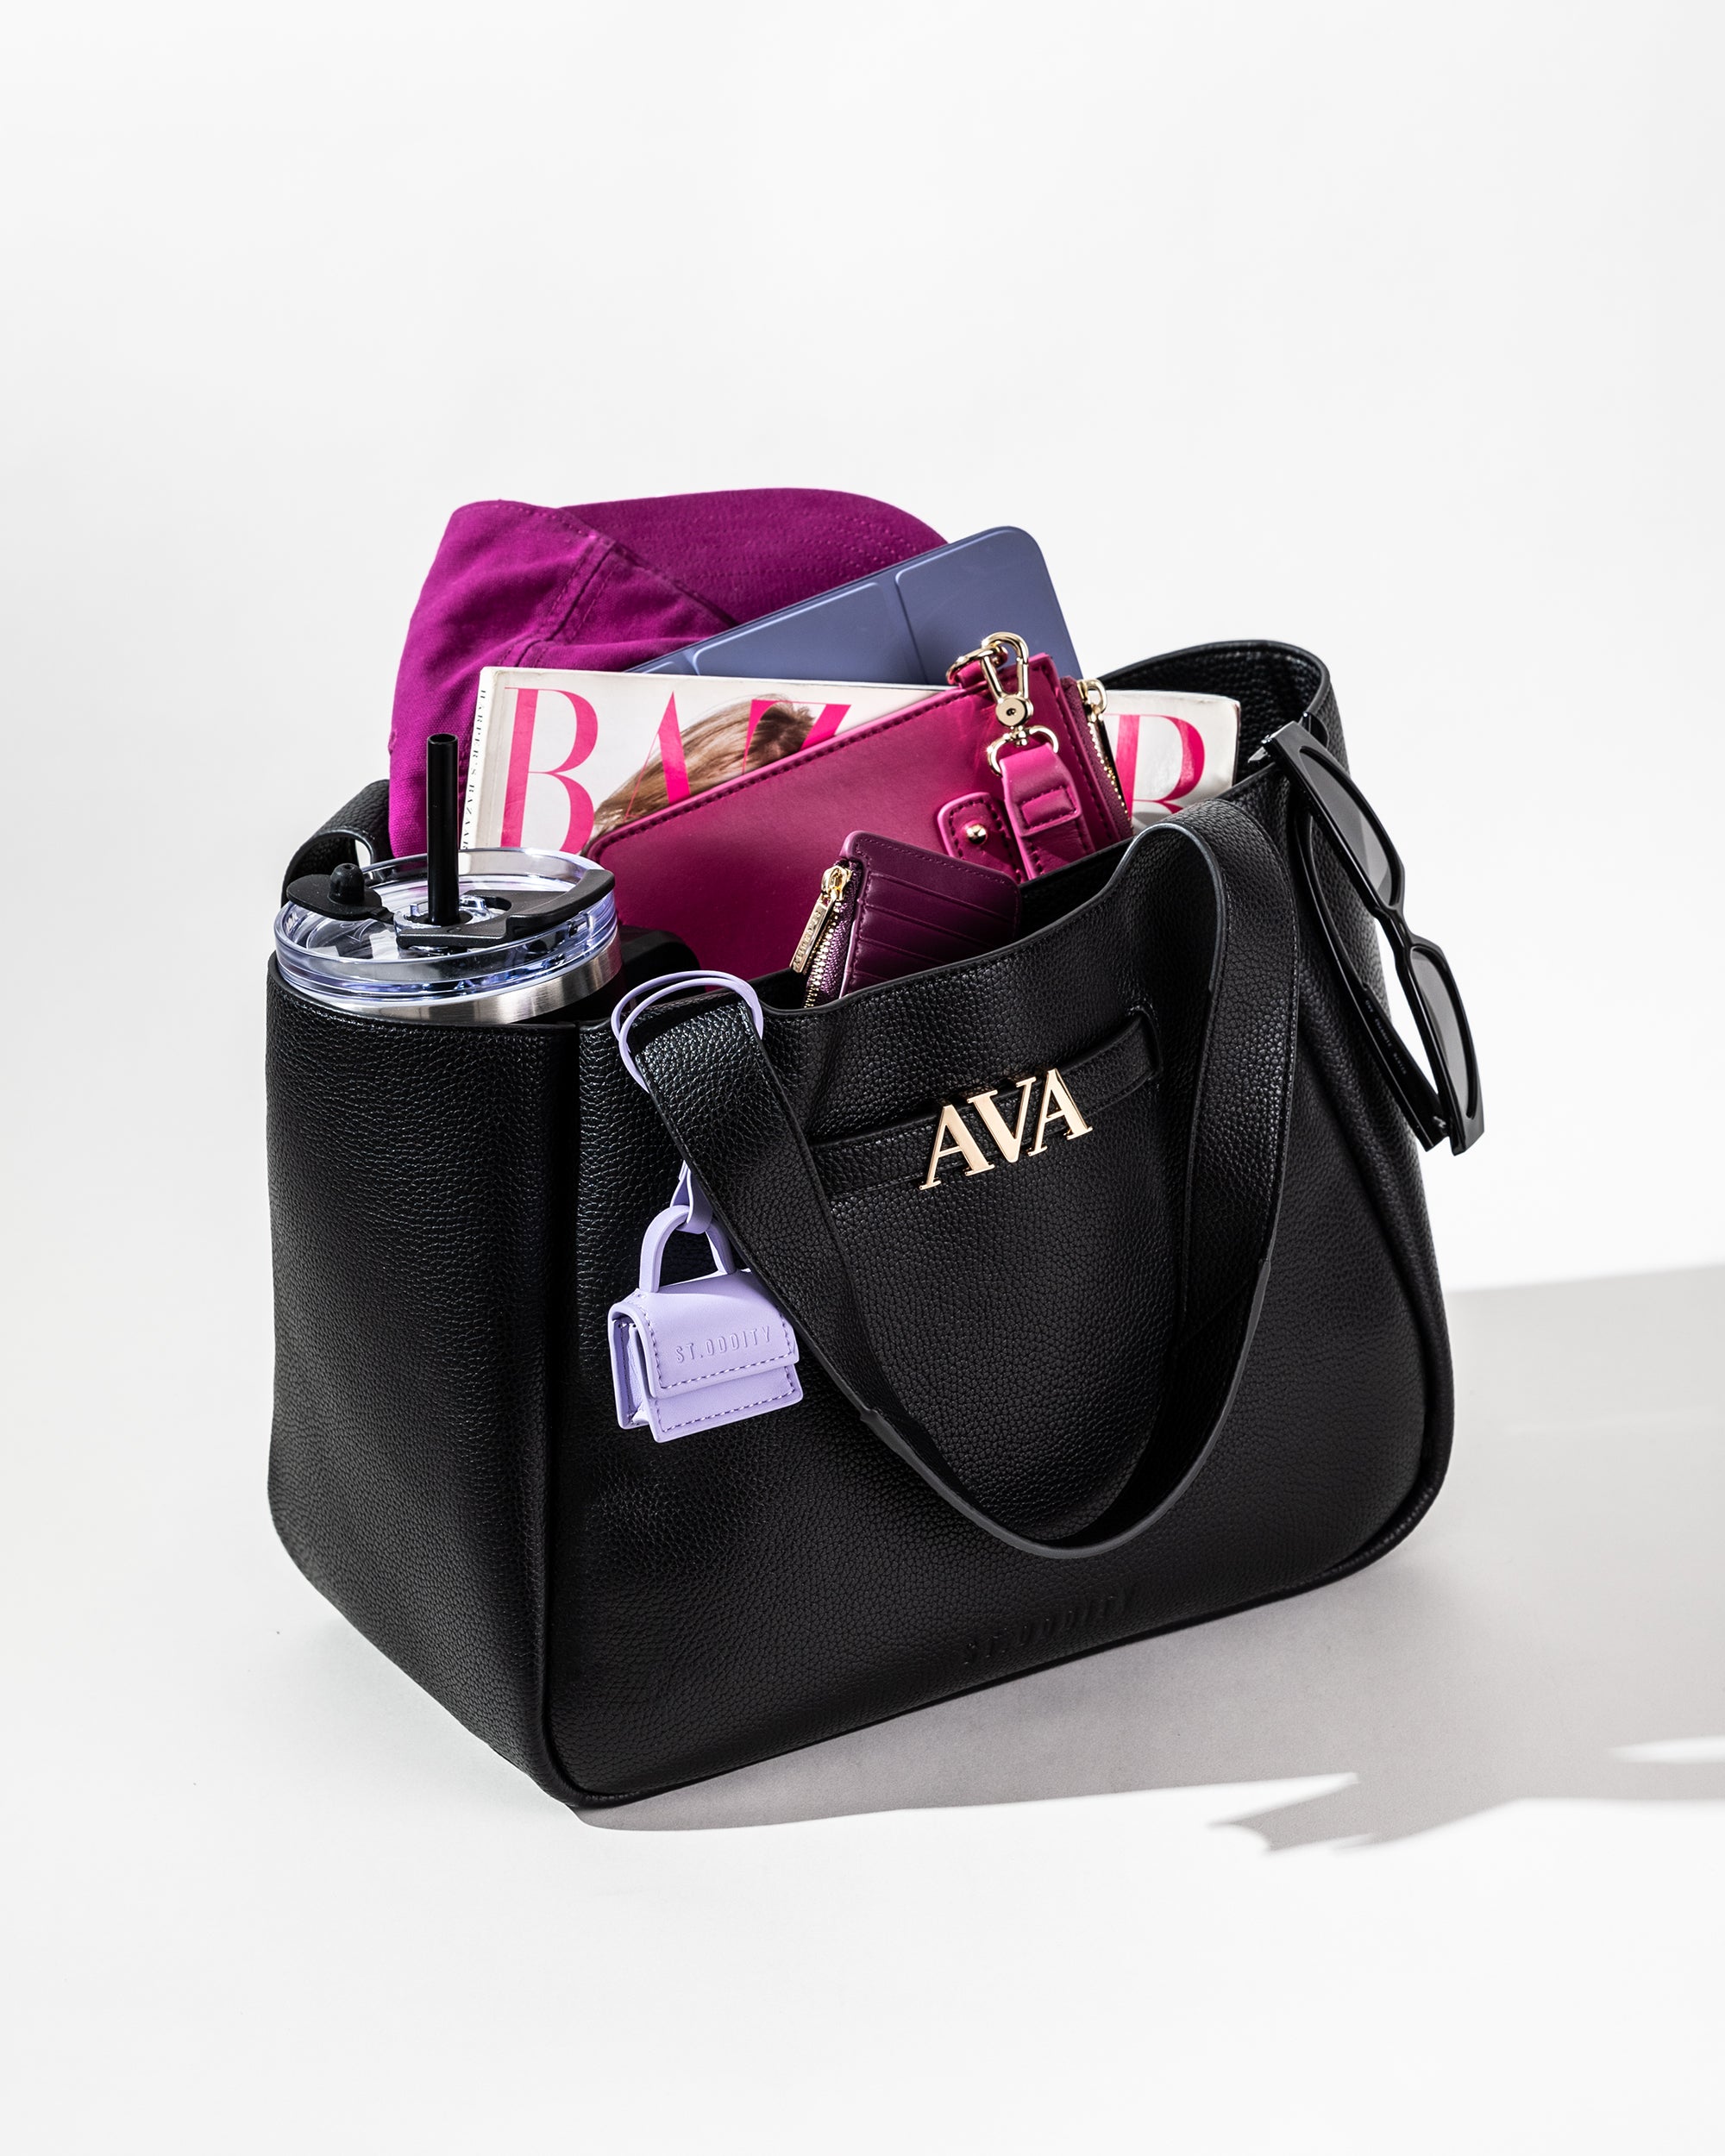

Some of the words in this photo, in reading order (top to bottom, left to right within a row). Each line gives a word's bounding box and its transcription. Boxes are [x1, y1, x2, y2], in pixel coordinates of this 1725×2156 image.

[471, 689, 486, 774] HARPER'S
[919, 1068, 1094, 1190] AVA
[675, 1325, 771, 1364] ST.ODDITY
